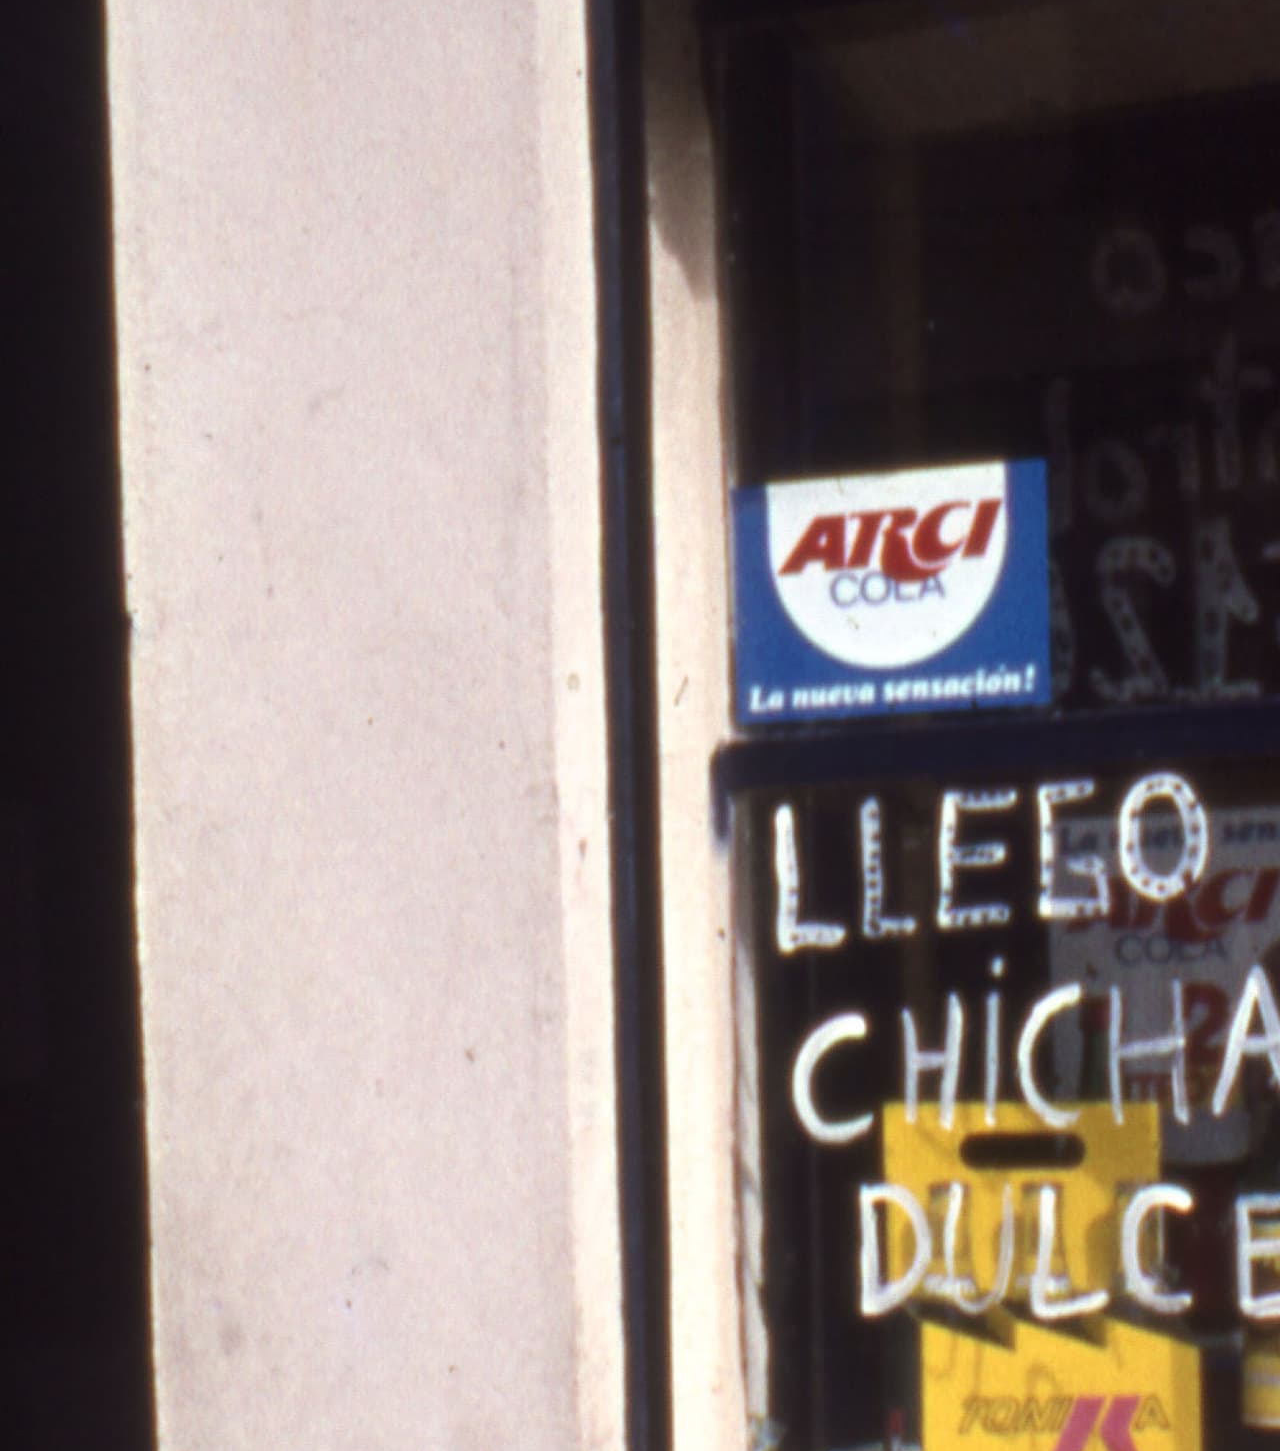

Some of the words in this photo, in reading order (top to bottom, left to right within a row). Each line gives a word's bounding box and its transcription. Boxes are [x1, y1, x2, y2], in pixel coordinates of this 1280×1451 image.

[778, 499, 1003, 576] ARCI
[828, 570, 947, 609] COLA
[748, 684, 785, 714] La
[791, 680, 876, 710] nueva
[882, 662, 1038, 703] sensación!
[775, 772, 1208, 954] LLEGO
[1113, 935, 1227, 966] COLA
